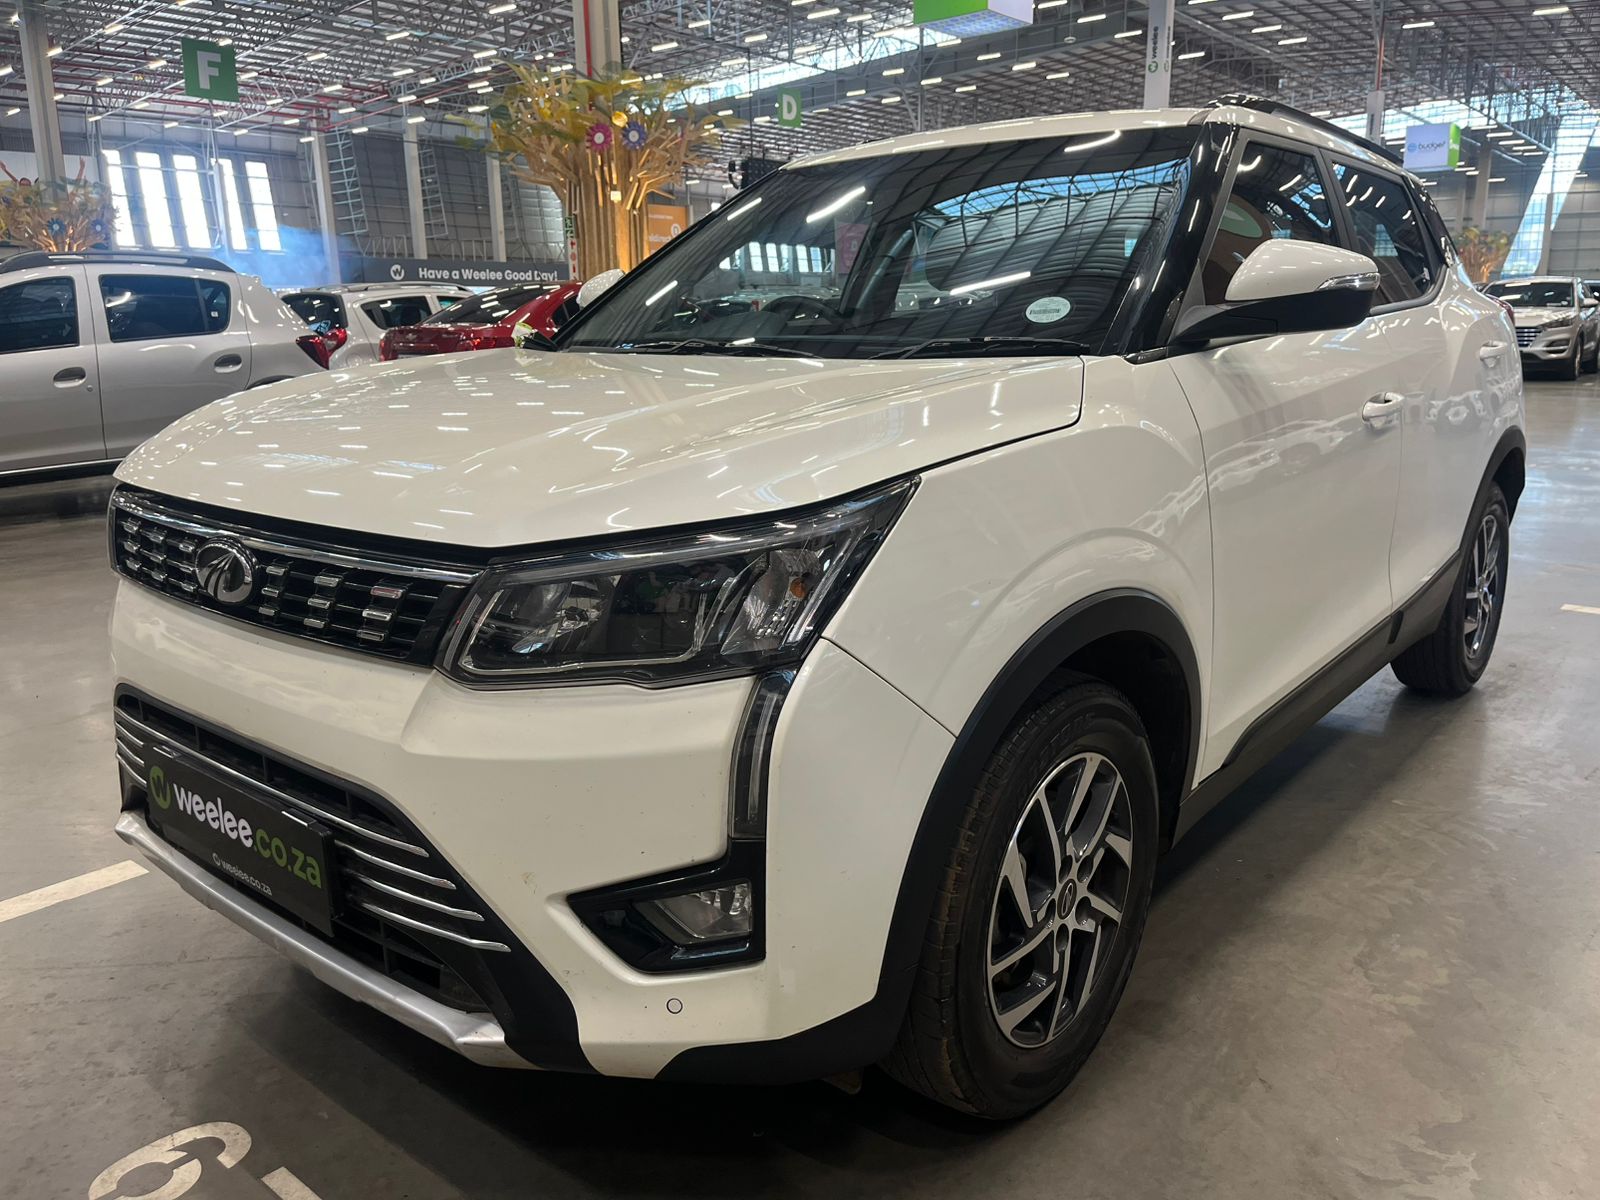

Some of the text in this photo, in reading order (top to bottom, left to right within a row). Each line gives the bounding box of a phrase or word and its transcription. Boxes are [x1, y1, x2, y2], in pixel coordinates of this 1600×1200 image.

[196, 50, 222, 90] F
[782, 94, 797, 120] D
[418, 267, 450, 279] Have
[451, 270, 460, 280] a
[461, 268, 503, 281] Weelee
[504, 269, 532, 281] Good
[534, 270, 558, 282] Day!
[173, 782, 322, 889] weelee.co.za
